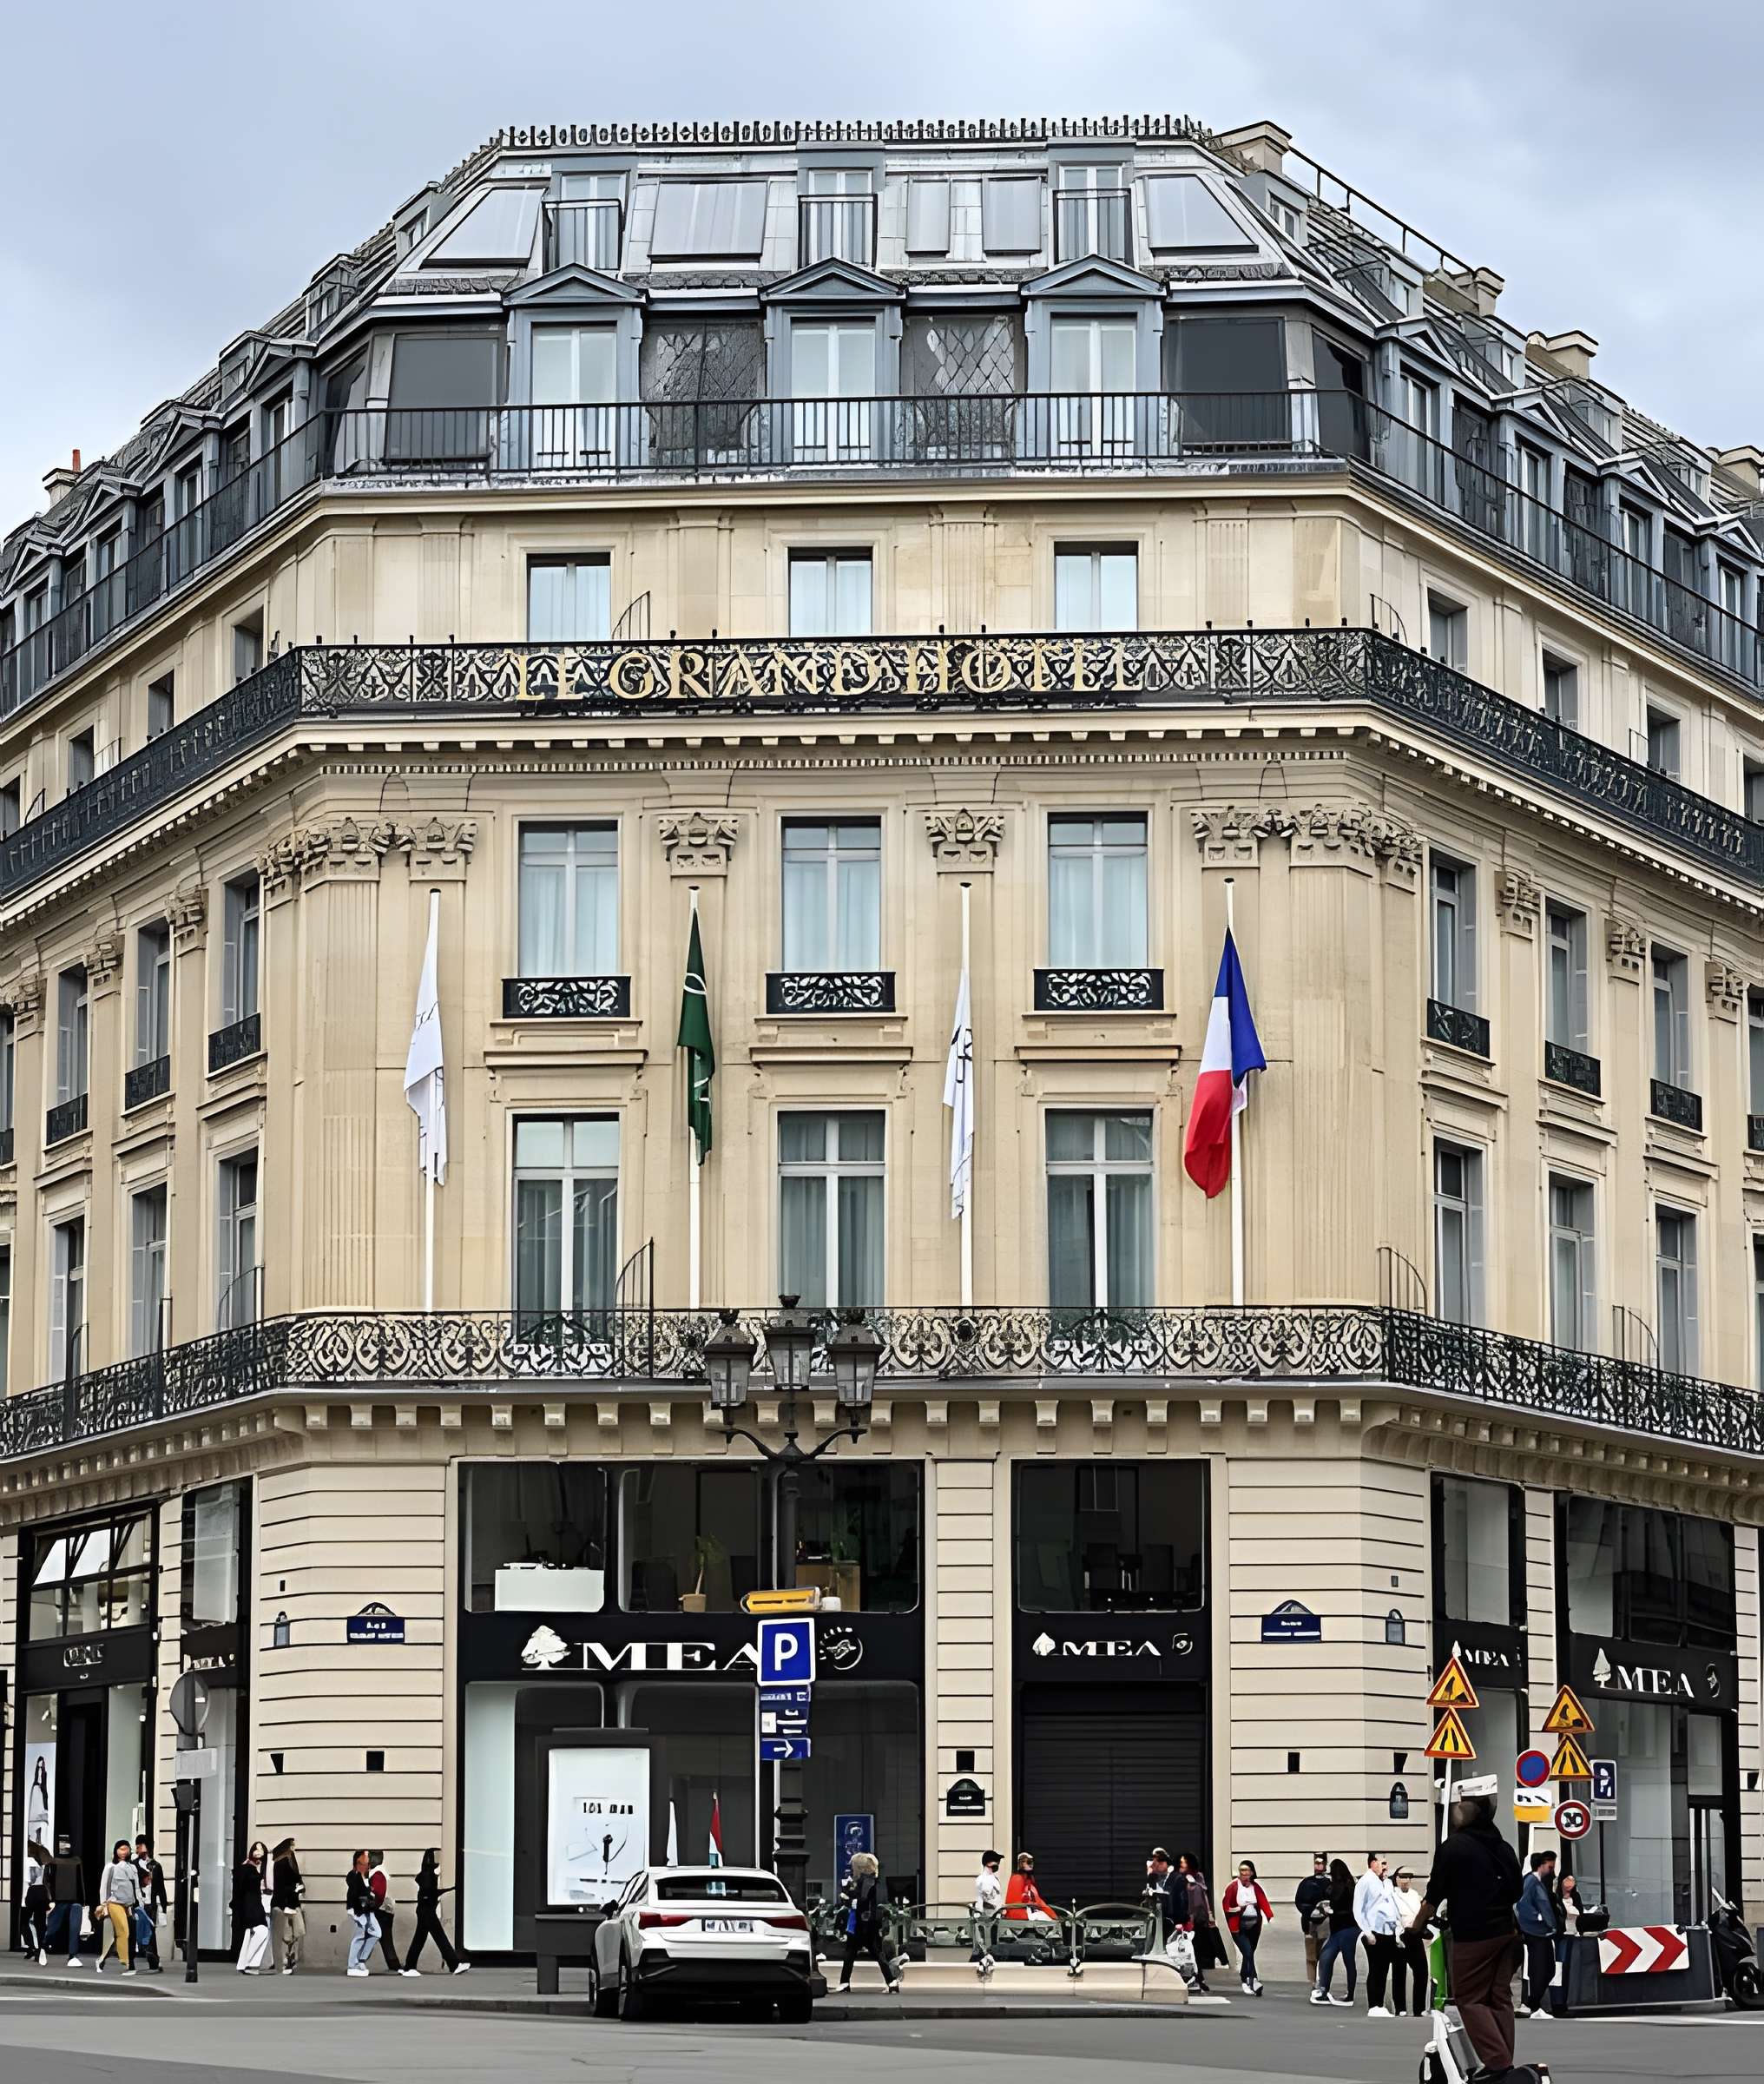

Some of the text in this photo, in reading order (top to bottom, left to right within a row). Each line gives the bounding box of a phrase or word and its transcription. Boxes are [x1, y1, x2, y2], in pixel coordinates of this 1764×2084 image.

[609, 648, 878, 700] GRAND
[901, 640, 1143, 695] HOTEL
[574, 1642, 758, 1671] MEA
[774, 1632, 799, 1672] P
[1063, 1639, 1162, 1657] MEA
[1616, 1665, 1695, 1698] MEA
